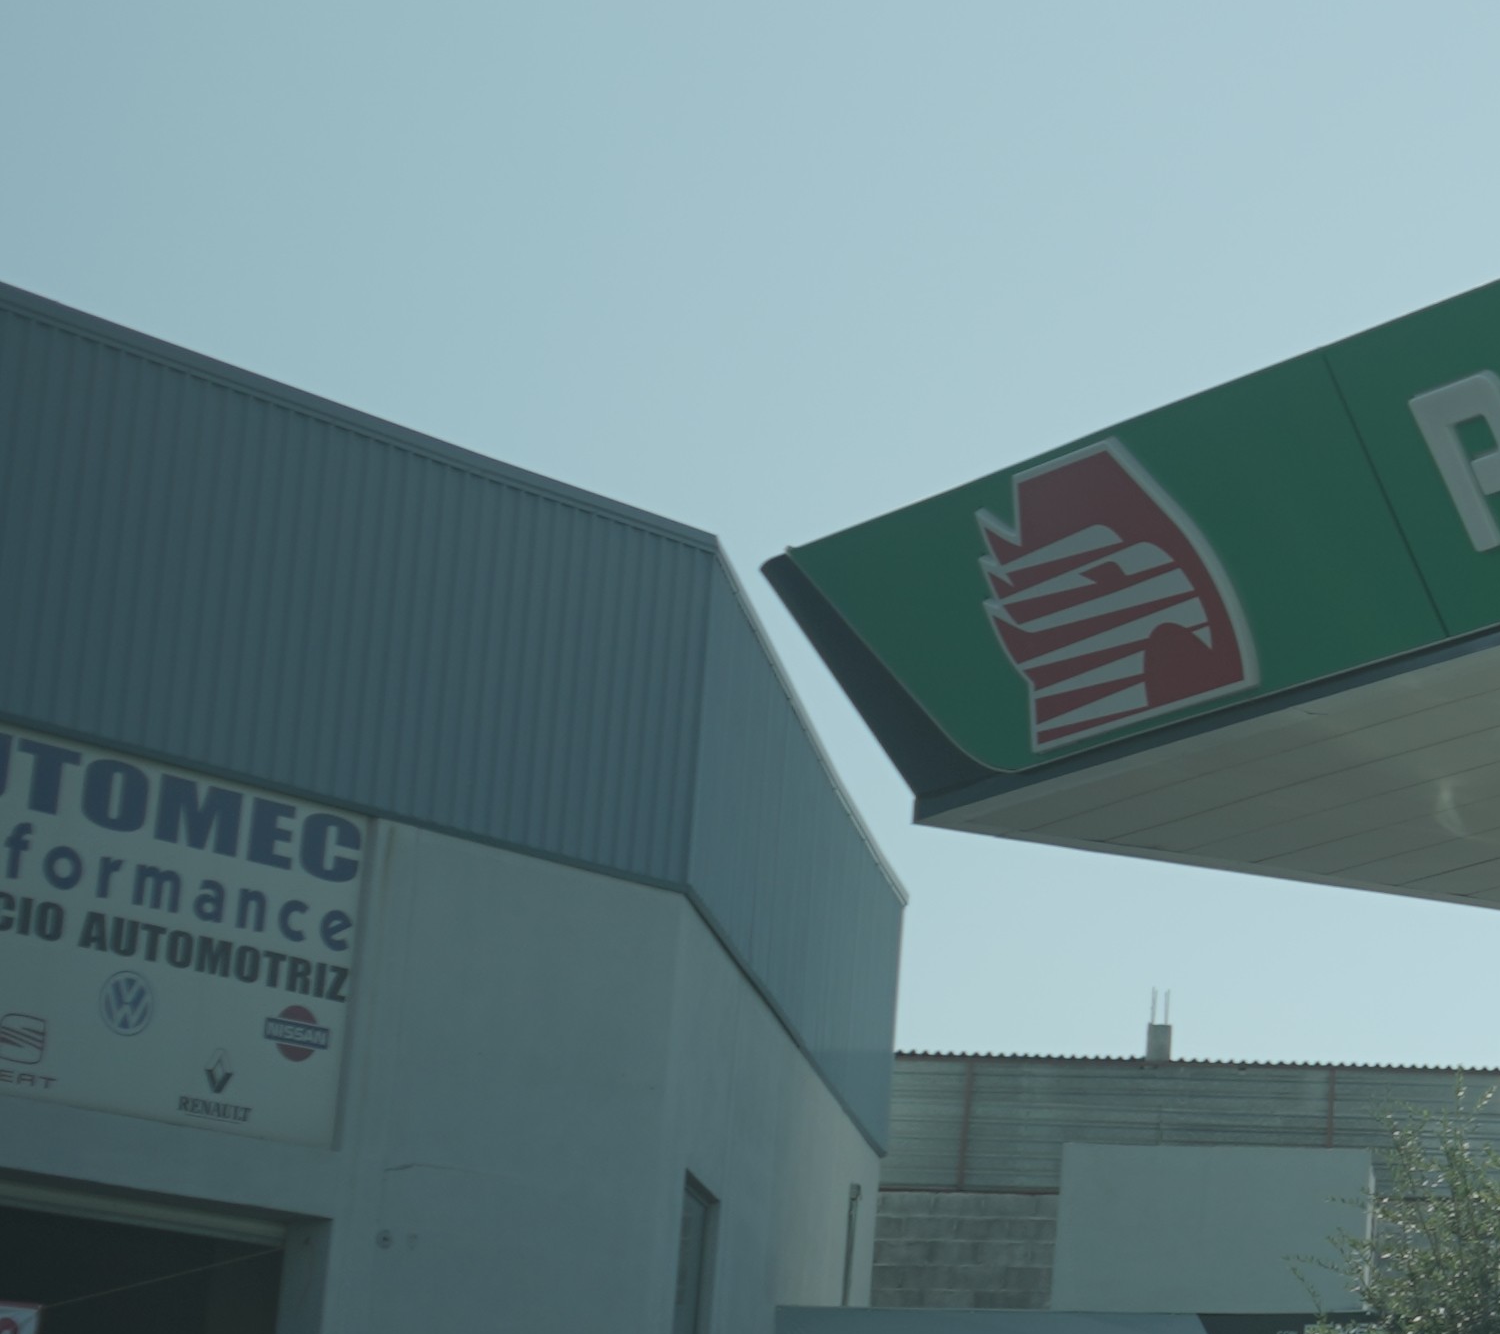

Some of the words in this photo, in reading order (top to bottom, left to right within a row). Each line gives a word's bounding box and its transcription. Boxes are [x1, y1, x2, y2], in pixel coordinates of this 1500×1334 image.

[0, 733, 362, 883] TOMEC
[5, 822, 353, 952] formance
[77, 910, 352, 1003] AUTOMOTRIZ
[267, 1021, 328, 1046] NISSAN
[177, 1096, 253, 1122] RENAULT
